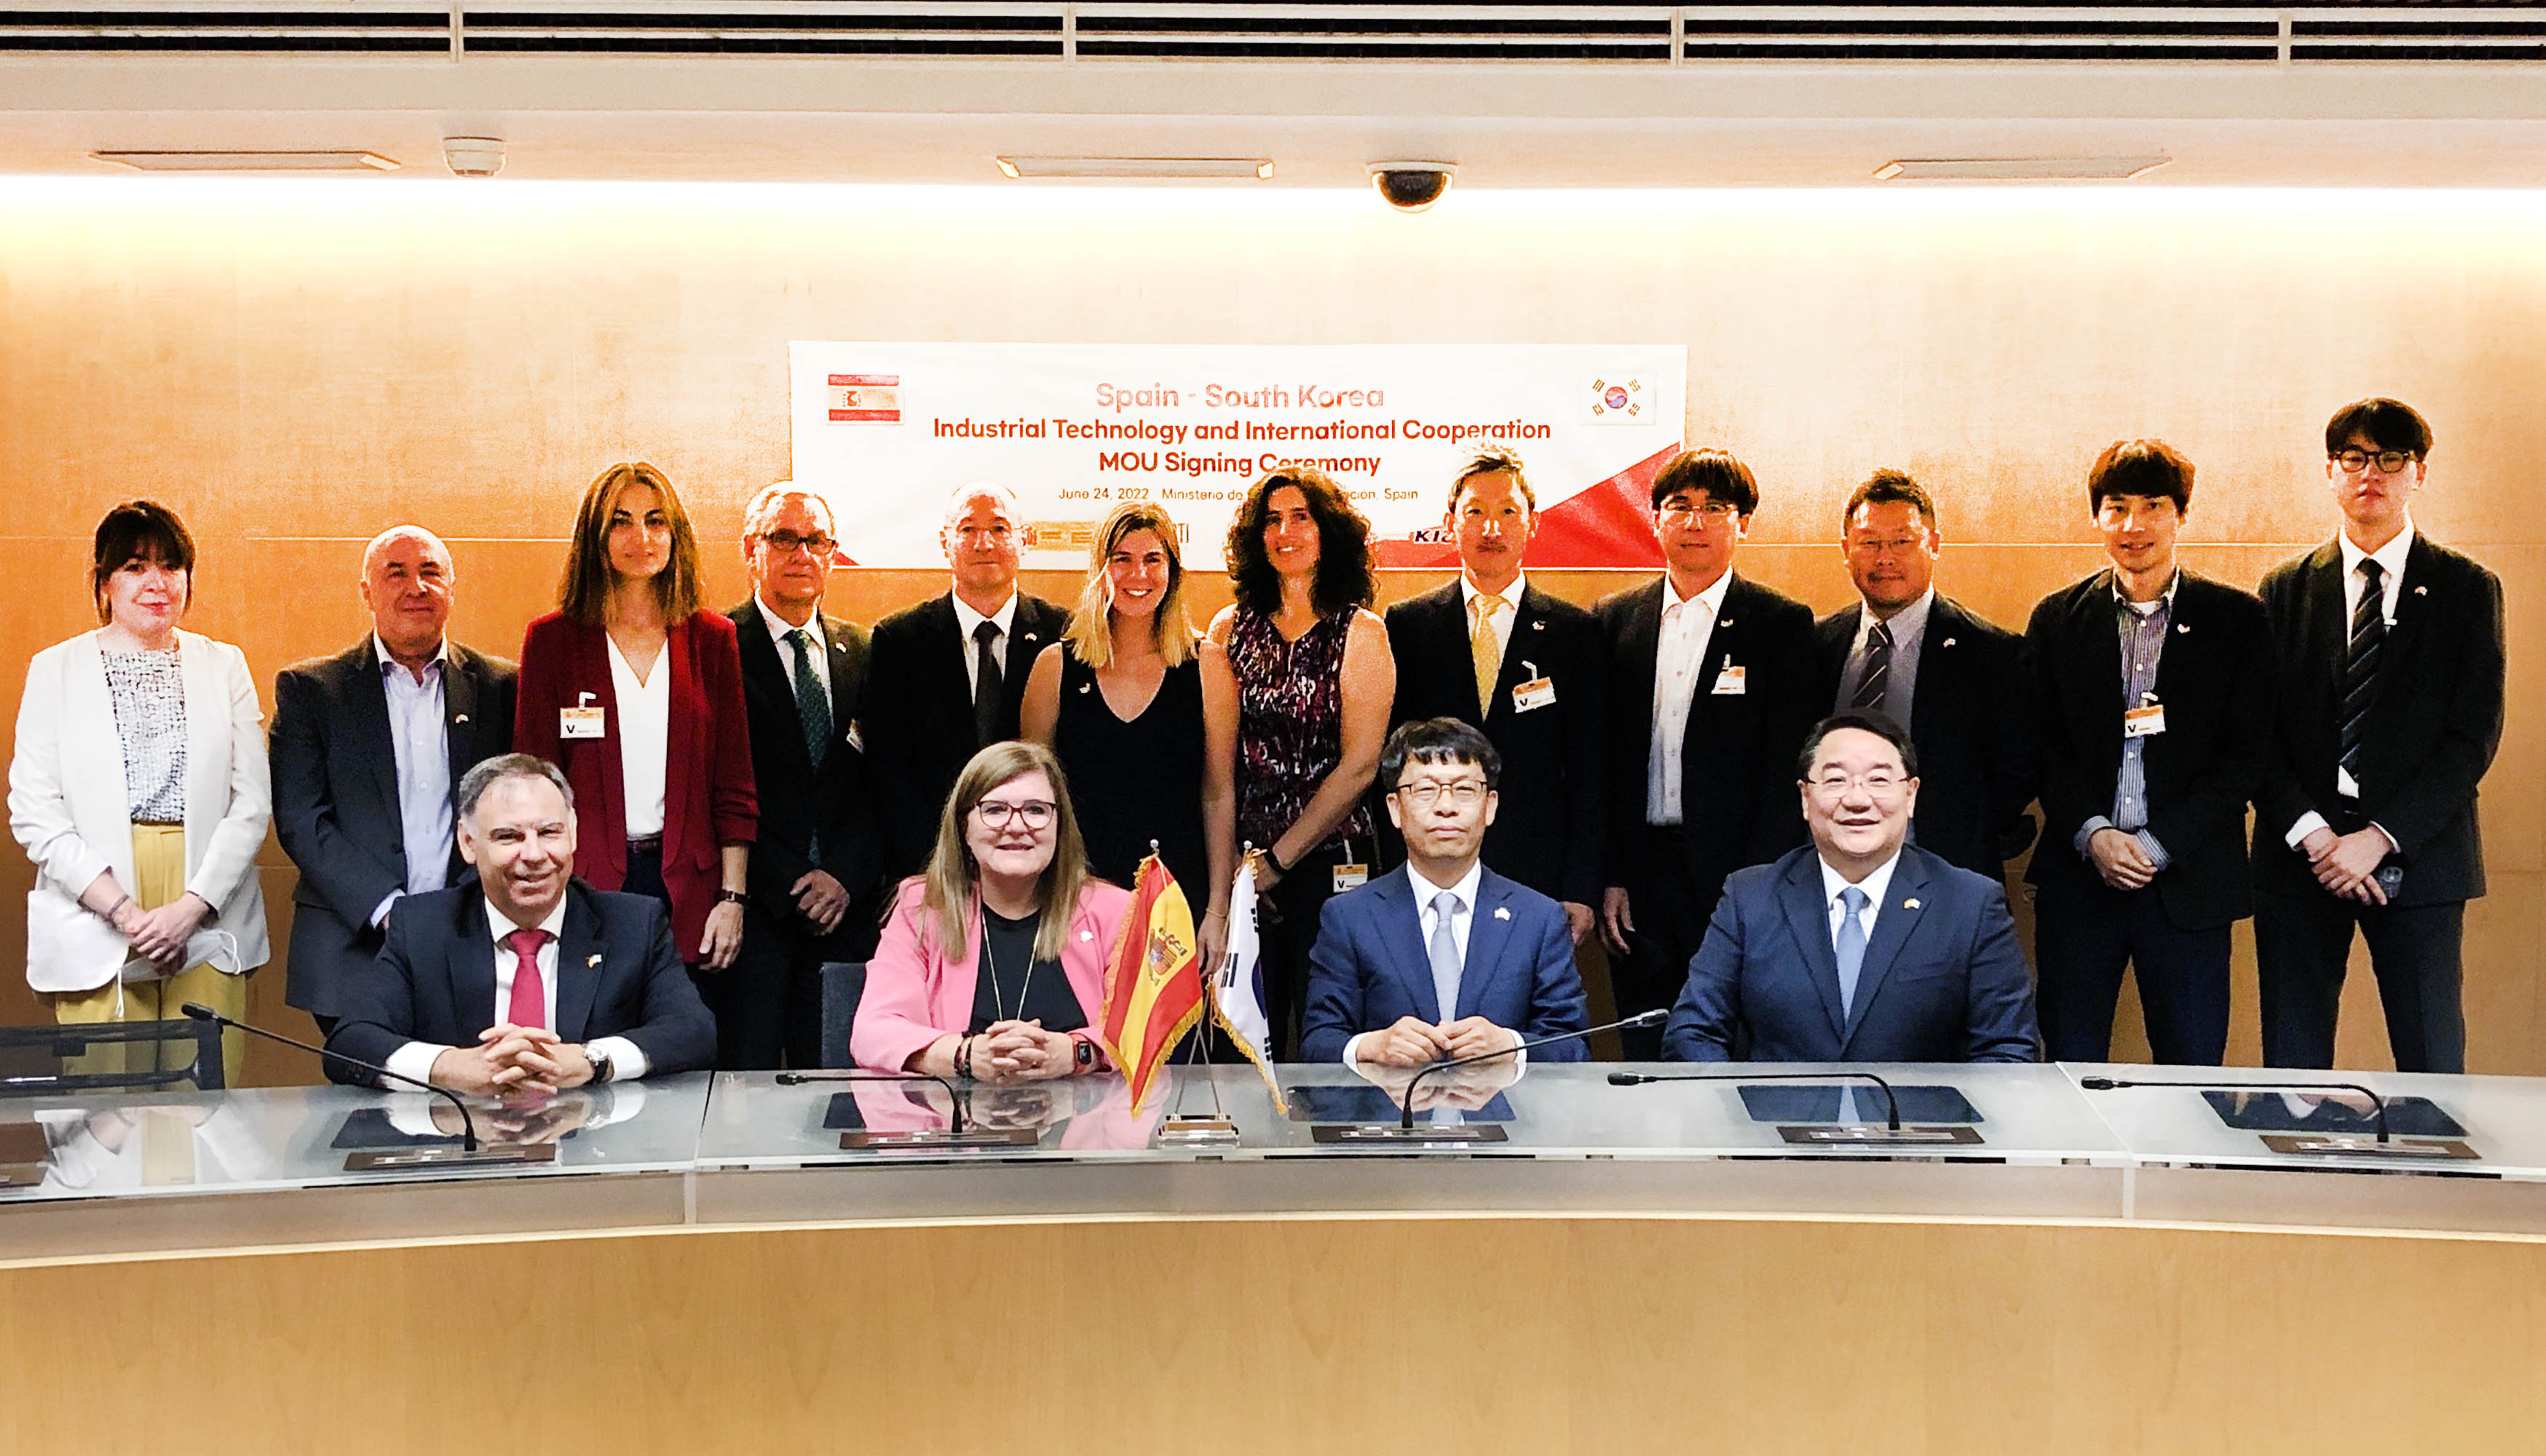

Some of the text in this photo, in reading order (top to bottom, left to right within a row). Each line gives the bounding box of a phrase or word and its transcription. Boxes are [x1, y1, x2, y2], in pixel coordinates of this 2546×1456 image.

[1096, 382, 1179, 413] Spain
[1206, 384, 1289, 408] South
[1298, 384, 1384, 408] Korea
[933, 417, 1551, 445] Industrial Technology and International Cooperation
[1099, 451, 1381, 478] MOU Signing Ceremony
[1058, 488, 1090, 499] June
[1094, 488, 1113, 501] 24,
[1118, 487, 1149, 500] 2022
[1161, 488, 1224, 500] Ministerio
[1384, 487, 1419, 501] Spain
[1519, 697, 1527, 706] V
[566, 724, 574, 733] V
[2127, 724, 2136, 732] V
[1337, 879, 1344, 888] V
